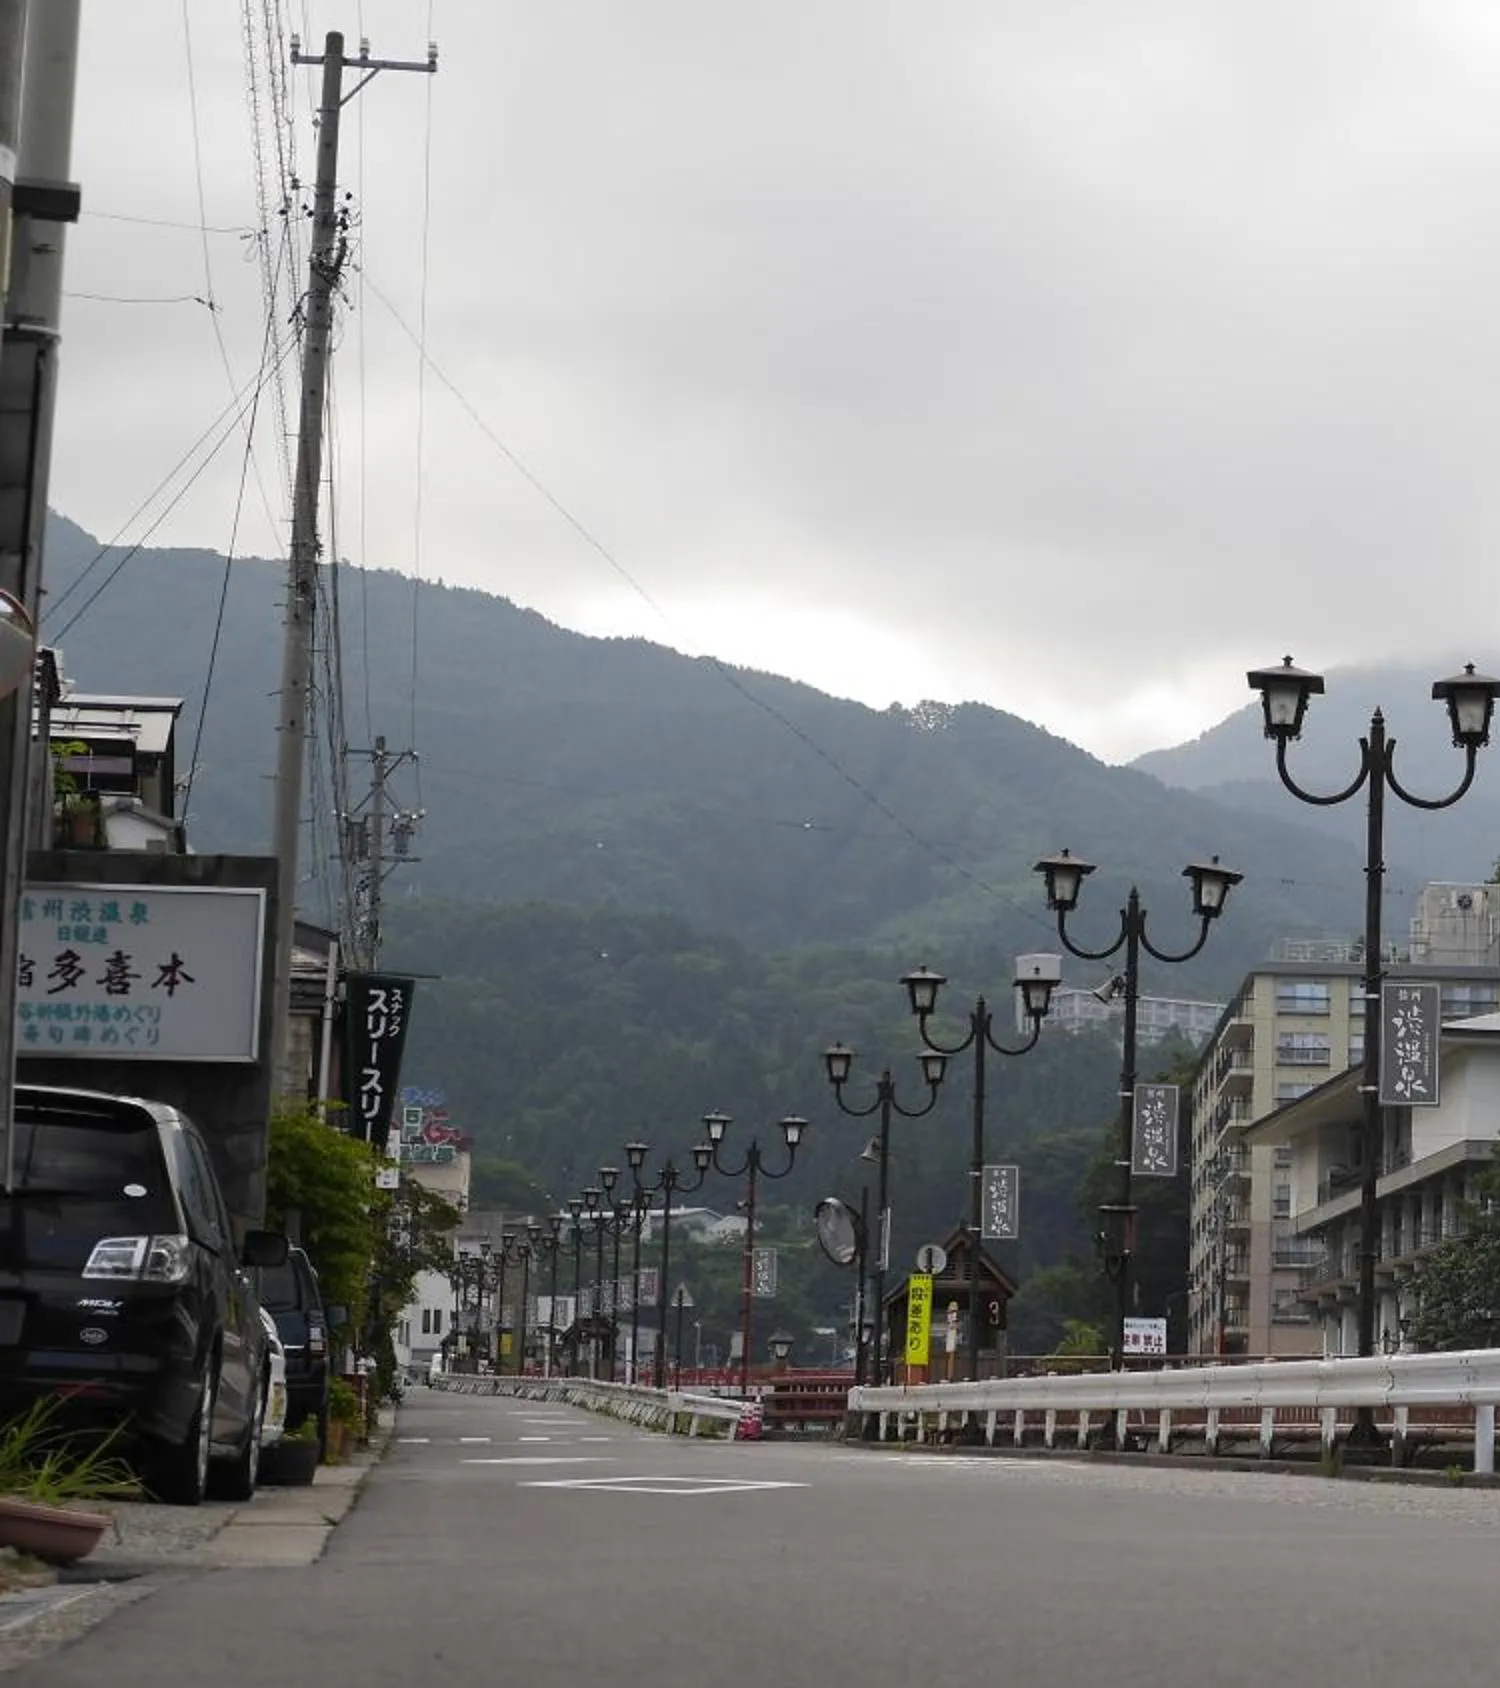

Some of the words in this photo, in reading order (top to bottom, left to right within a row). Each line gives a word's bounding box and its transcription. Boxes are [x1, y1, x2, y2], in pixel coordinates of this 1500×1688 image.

[390, 988, 404, 1037] スナック
[1392, 1004, 1428, 1099] 渋温泉
[361, 989, 389, 1142] スリースリー
